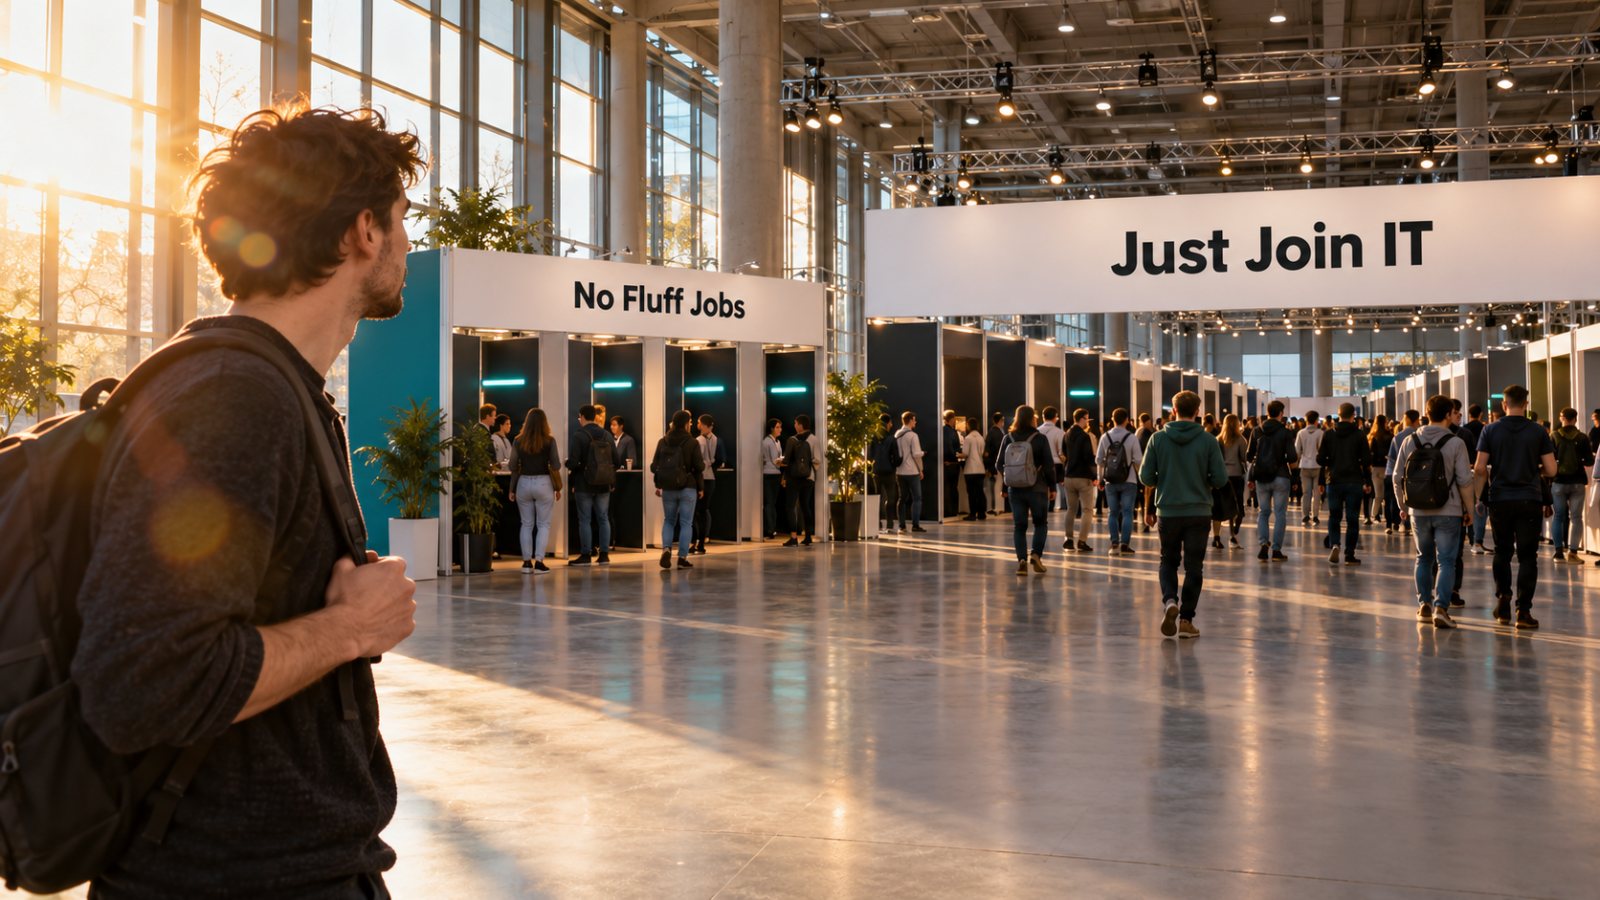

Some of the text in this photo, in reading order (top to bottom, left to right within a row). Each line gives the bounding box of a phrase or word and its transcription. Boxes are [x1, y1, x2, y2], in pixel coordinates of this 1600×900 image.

[1110, 220, 1434, 276] Just Join IT
[574, 280, 746, 319] No Fluff Jobs
